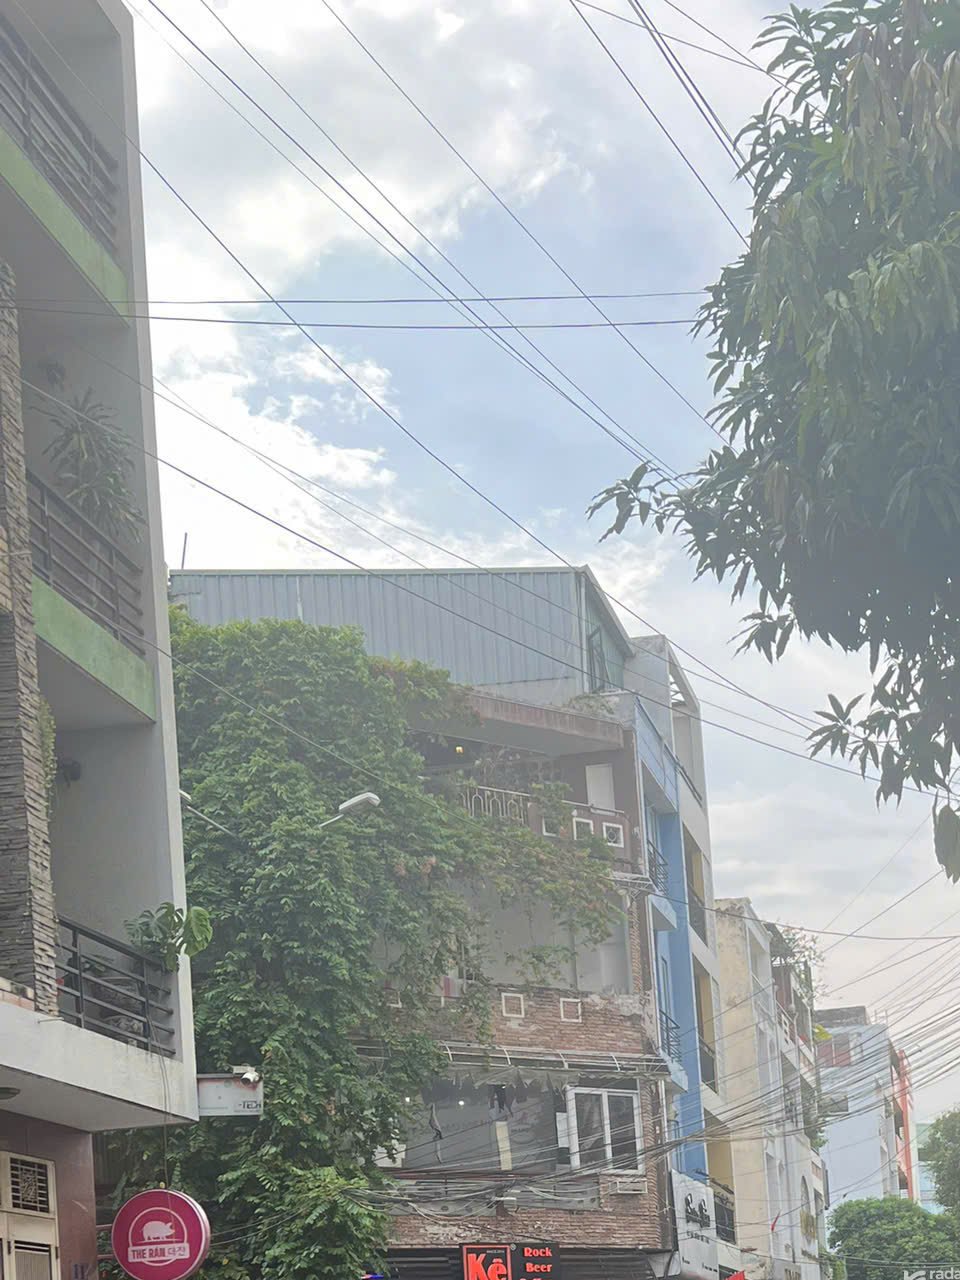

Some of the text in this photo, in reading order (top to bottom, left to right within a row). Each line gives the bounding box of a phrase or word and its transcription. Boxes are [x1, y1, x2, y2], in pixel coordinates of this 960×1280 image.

[131, 1249, 147, 1259] THE
[524, 1247, 553, 1257] Rock
[525, 1262, 553, 1273] Beer
